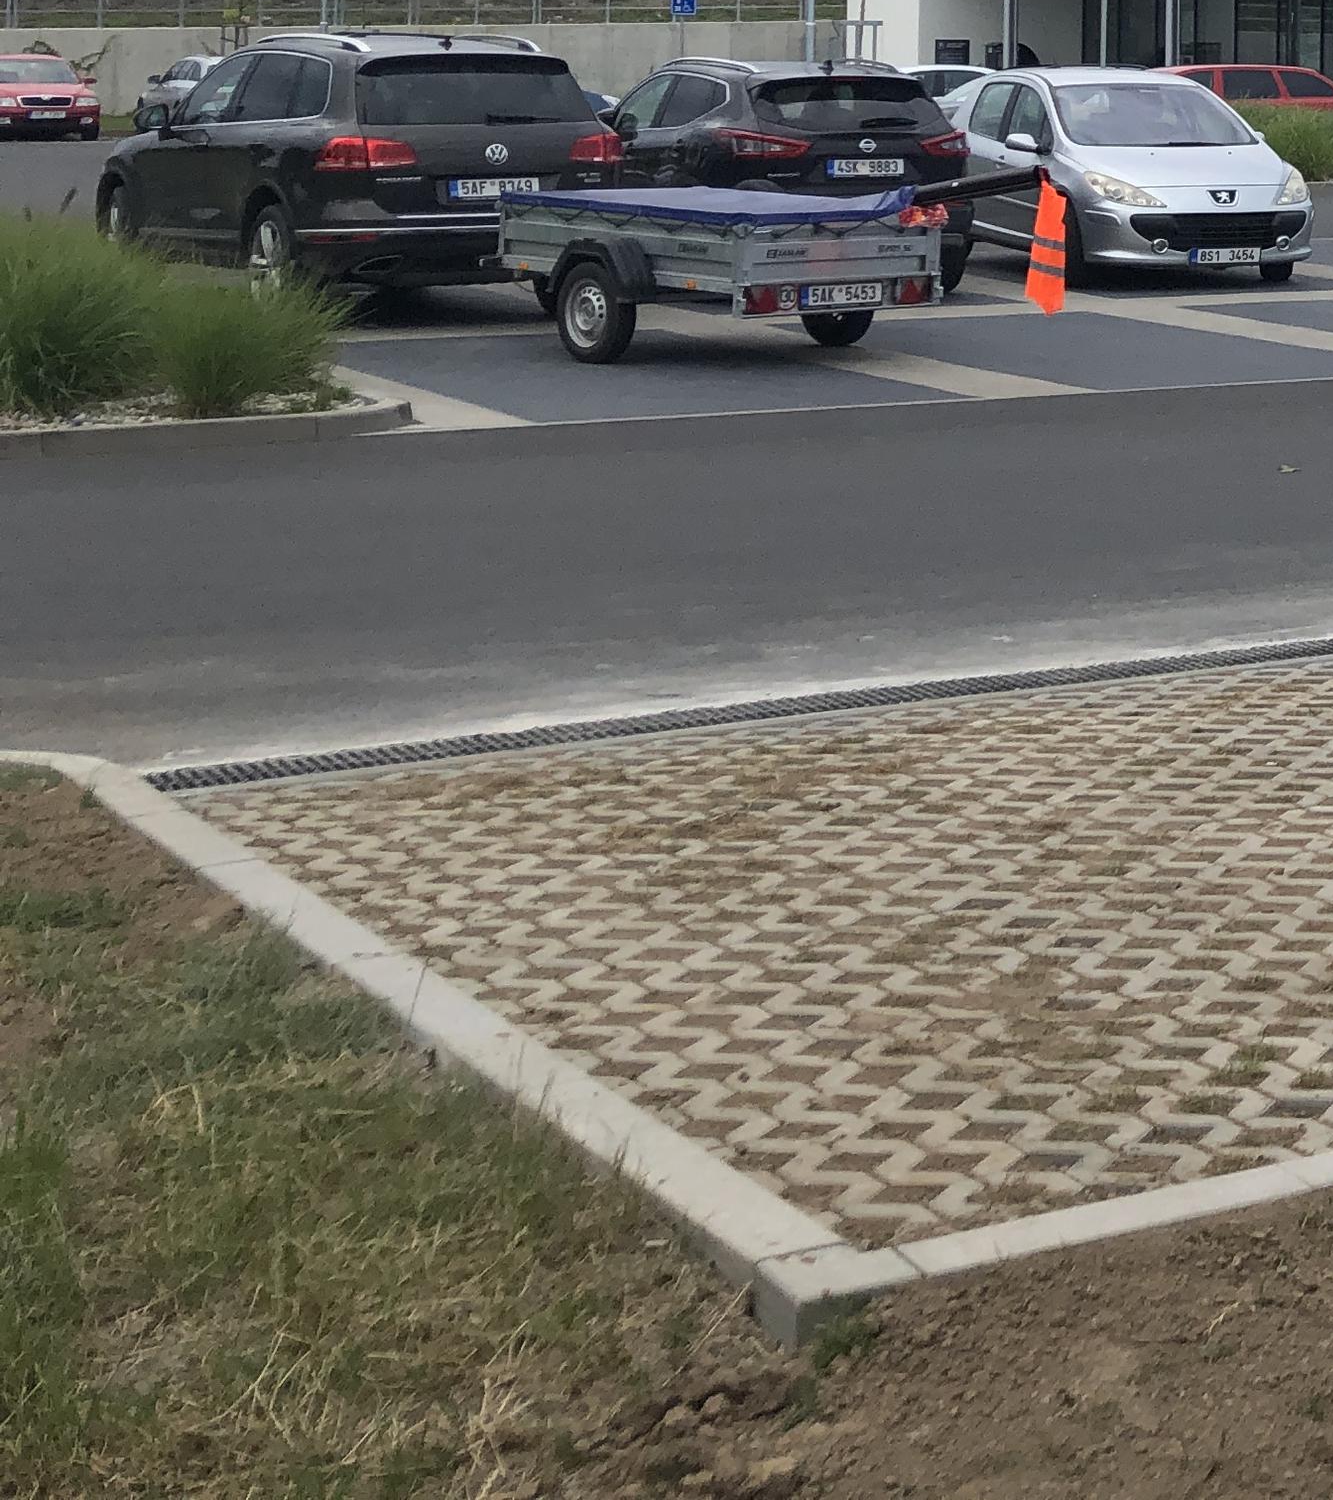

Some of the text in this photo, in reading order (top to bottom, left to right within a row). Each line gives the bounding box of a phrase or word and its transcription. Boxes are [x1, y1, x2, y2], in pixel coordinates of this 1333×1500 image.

[837, 161, 859, 173] 4SK
[461, 181, 486, 195] 5AF
[1200, 249, 1255, 262] 8S1 3454
[811, 284, 876, 305] 5AK 5453
